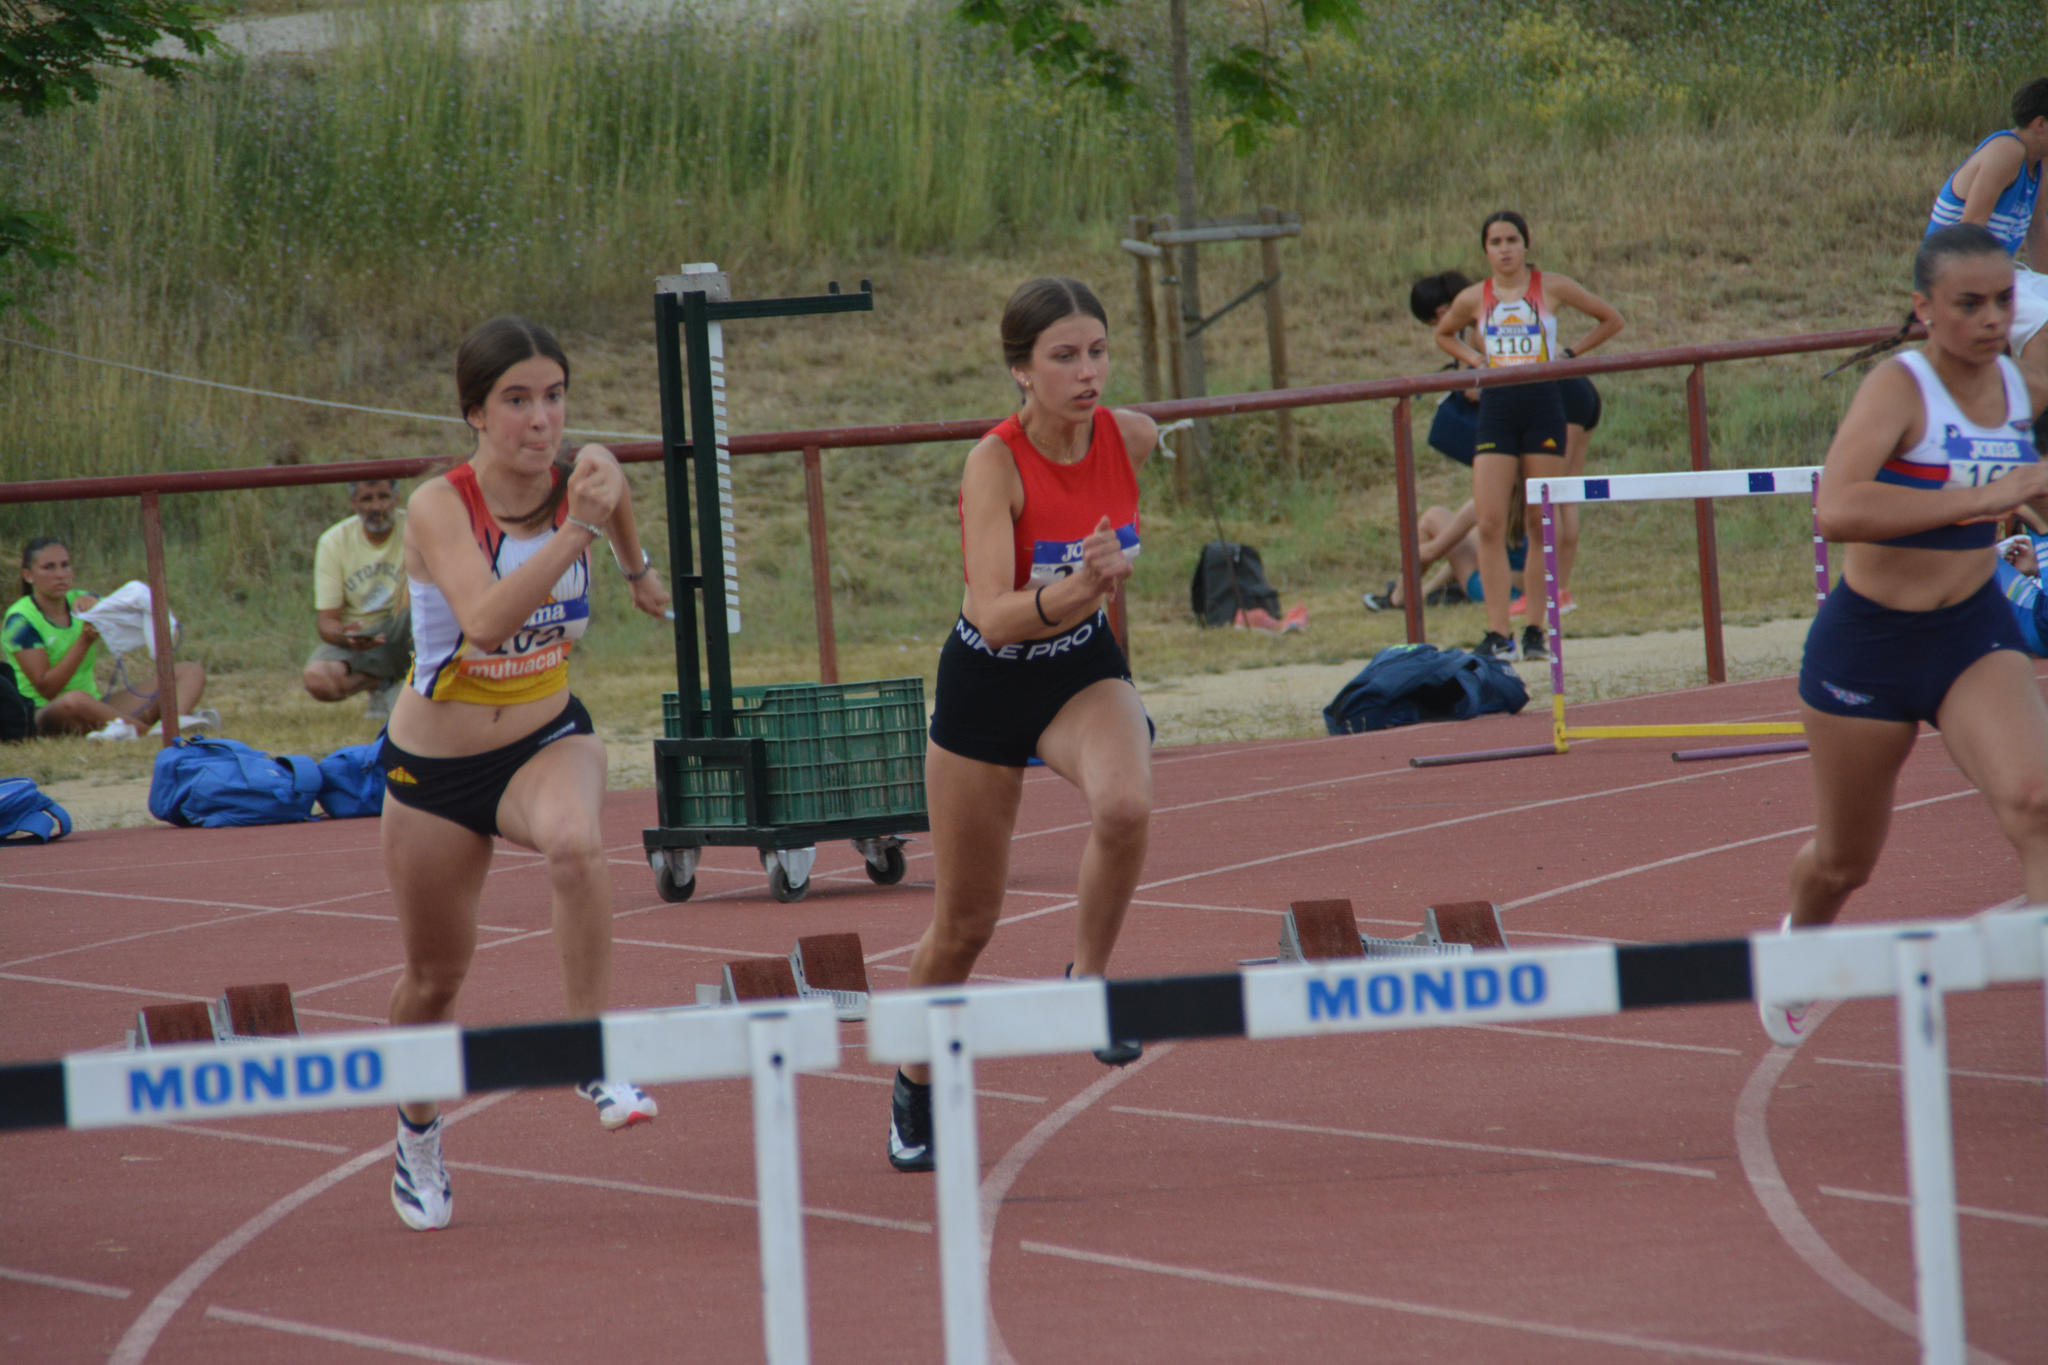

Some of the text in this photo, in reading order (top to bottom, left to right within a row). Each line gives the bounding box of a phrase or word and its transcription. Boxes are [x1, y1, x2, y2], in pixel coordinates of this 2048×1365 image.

[1496, 337, 1532, 354] 110
[1968, 463, 2019, 488] 16
[1026, 623, 1093, 661] PRO
[467, 646, 563, 679] mutuacat
[1306, 962, 1547, 1022] MONDO
[128, 1047, 384, 1113] MONDO
